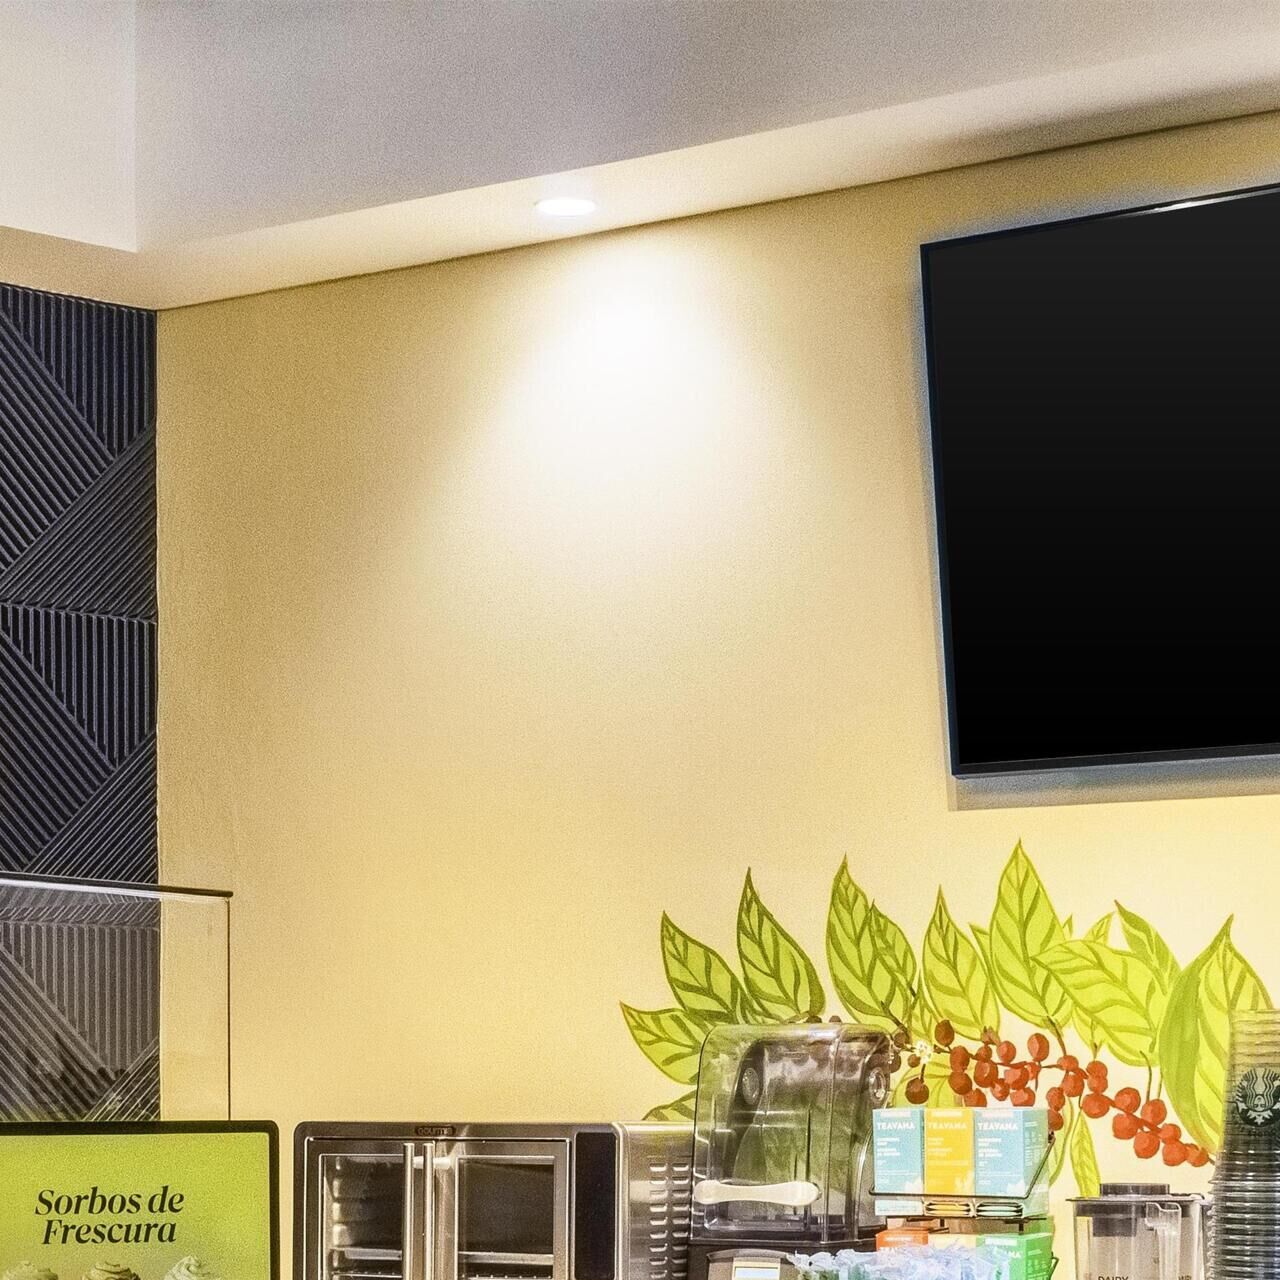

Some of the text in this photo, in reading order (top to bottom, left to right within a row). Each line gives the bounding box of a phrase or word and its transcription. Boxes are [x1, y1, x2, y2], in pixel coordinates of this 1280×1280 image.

[877, 1122, 916, 1130] TEAVANA
[928, 1122, 968, 1130] TEAVANA
[977, 1122, 1019, 1131] TEAVANA
[35, 1185, 185, 1216] Sorbos de
[42, 1219, 177, 1245] Frescura
